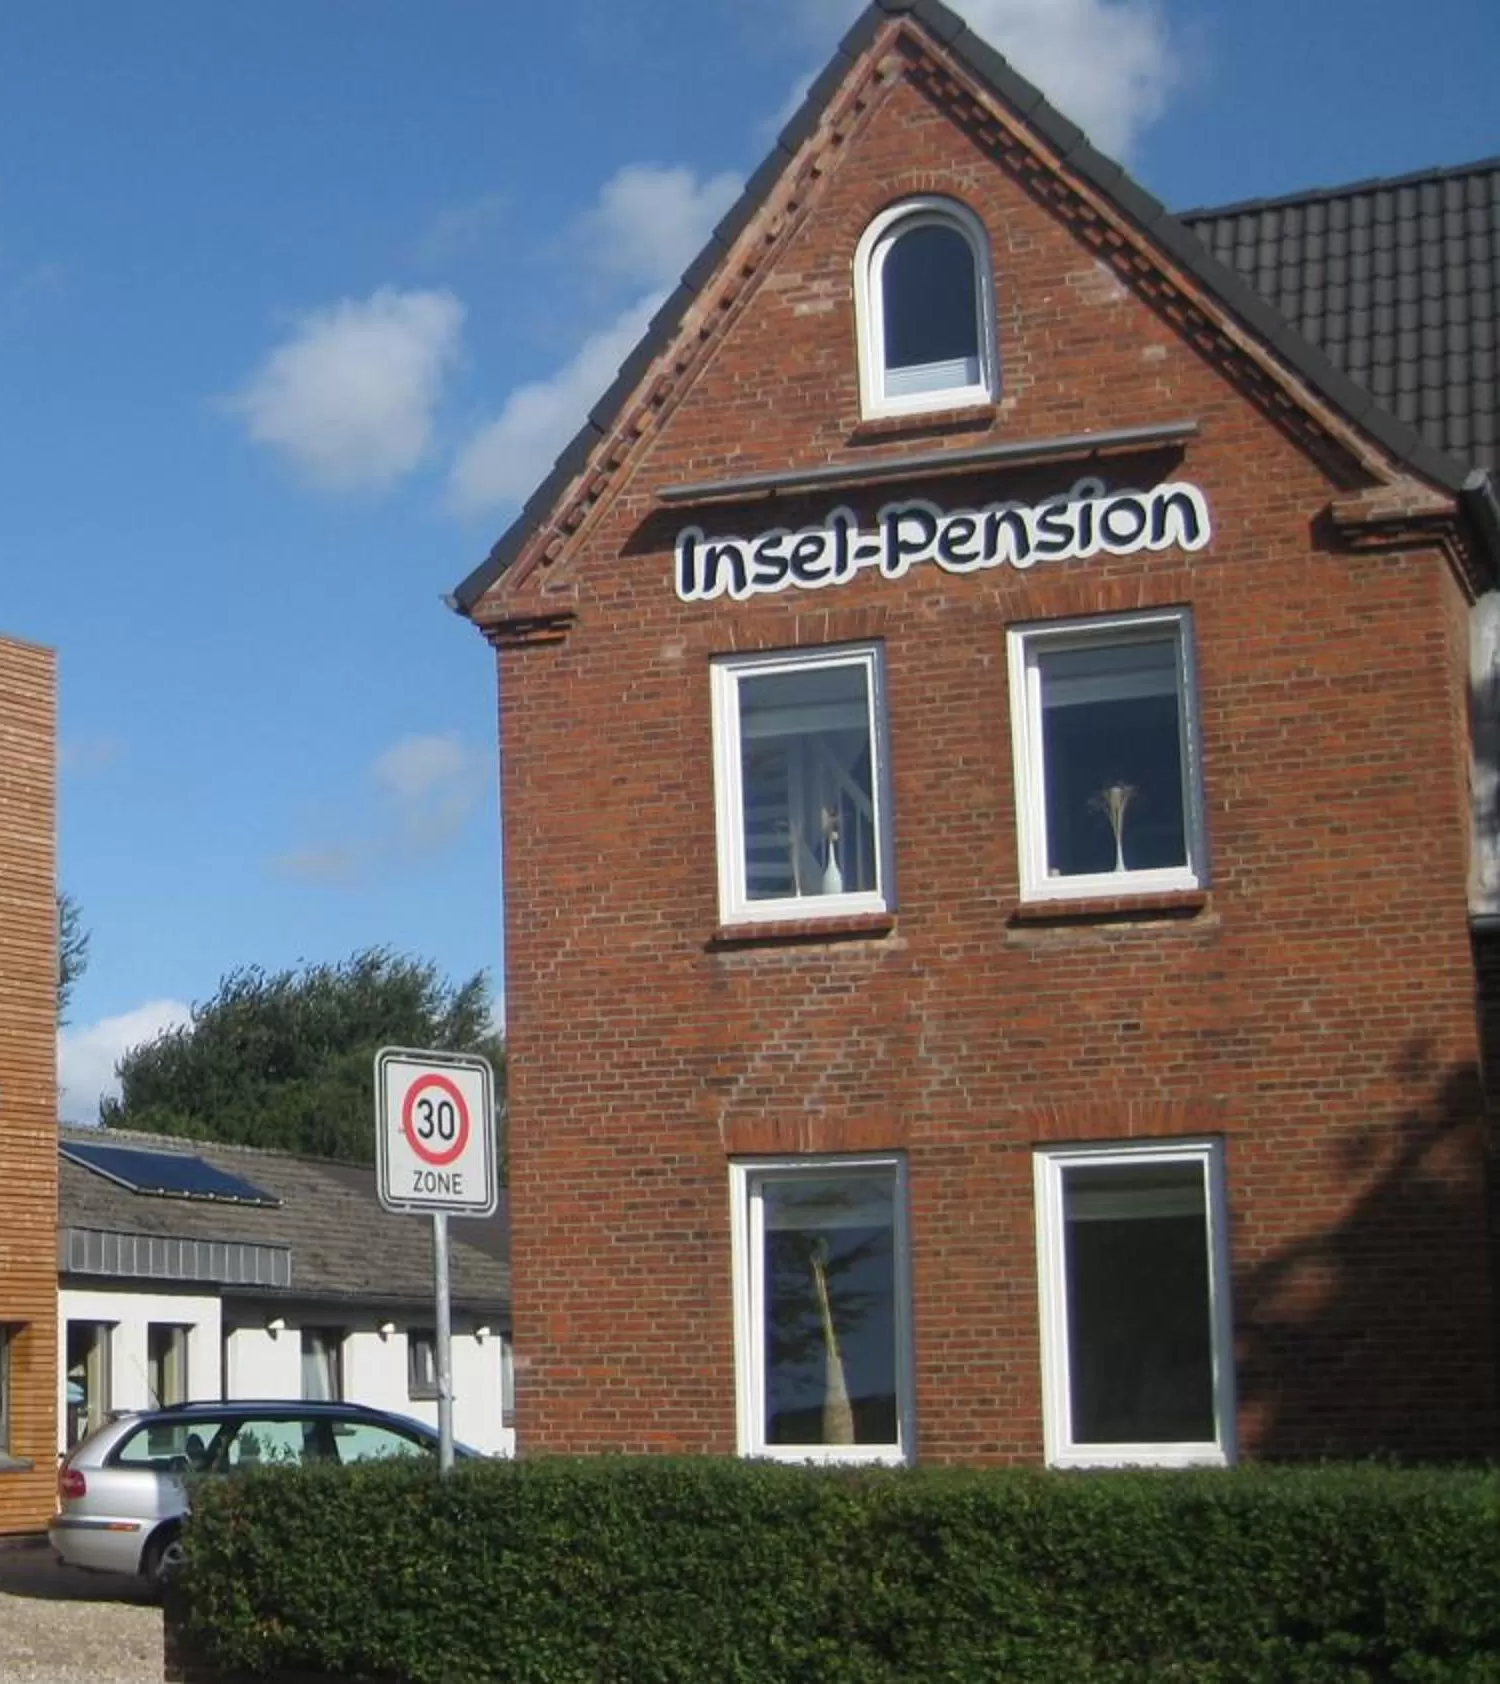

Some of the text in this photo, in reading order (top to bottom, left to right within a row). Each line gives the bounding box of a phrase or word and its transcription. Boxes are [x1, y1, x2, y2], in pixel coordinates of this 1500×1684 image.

[676, 482, 1204, 599] Insel-Pension
[417, 1098, 455, 1140] 30
[413, 1170, 463, 1194] ZONE
